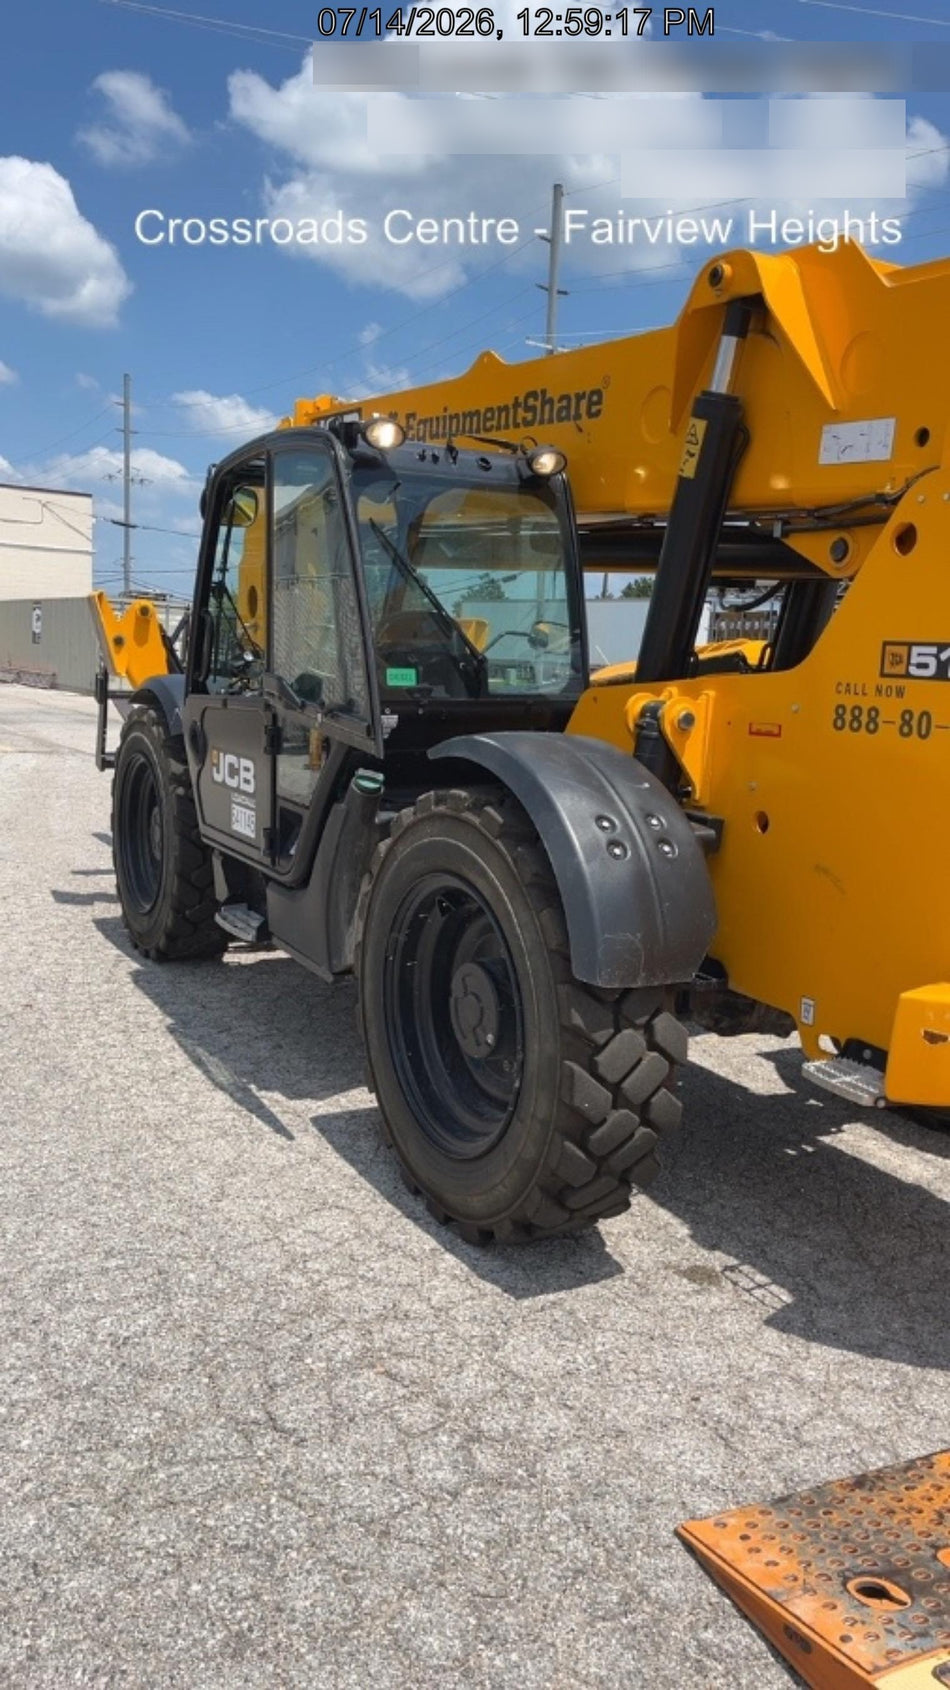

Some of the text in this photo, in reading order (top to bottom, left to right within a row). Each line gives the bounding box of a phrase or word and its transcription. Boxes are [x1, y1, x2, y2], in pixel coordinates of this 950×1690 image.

[403, 387, 604, 443] EquipmentShare
[835, 682, 906, 699] CALL NOW
[211, 750, 255, 793] JCB
